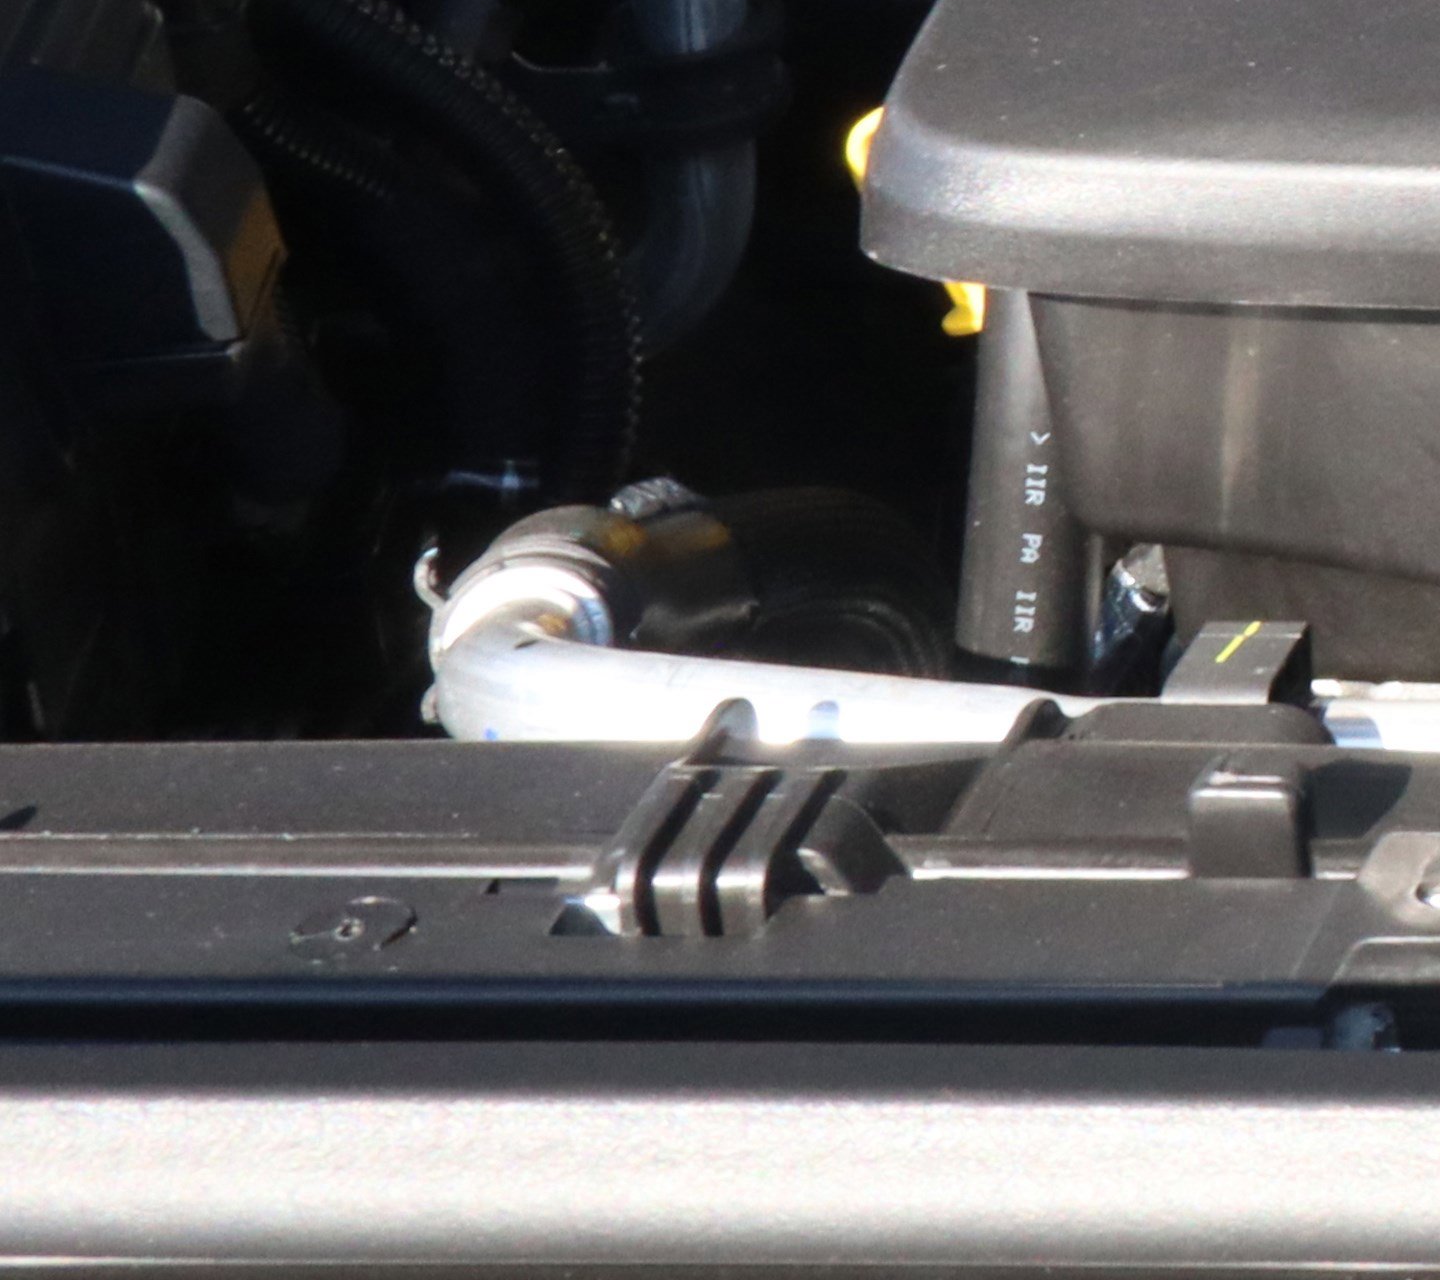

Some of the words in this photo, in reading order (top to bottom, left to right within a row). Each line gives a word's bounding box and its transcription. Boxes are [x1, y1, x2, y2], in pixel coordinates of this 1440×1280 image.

[1025, 463, 1049, 506] IIR
[1020, 532, 1044, 563] PA
[1013, 591, 1038, 634] IIR
